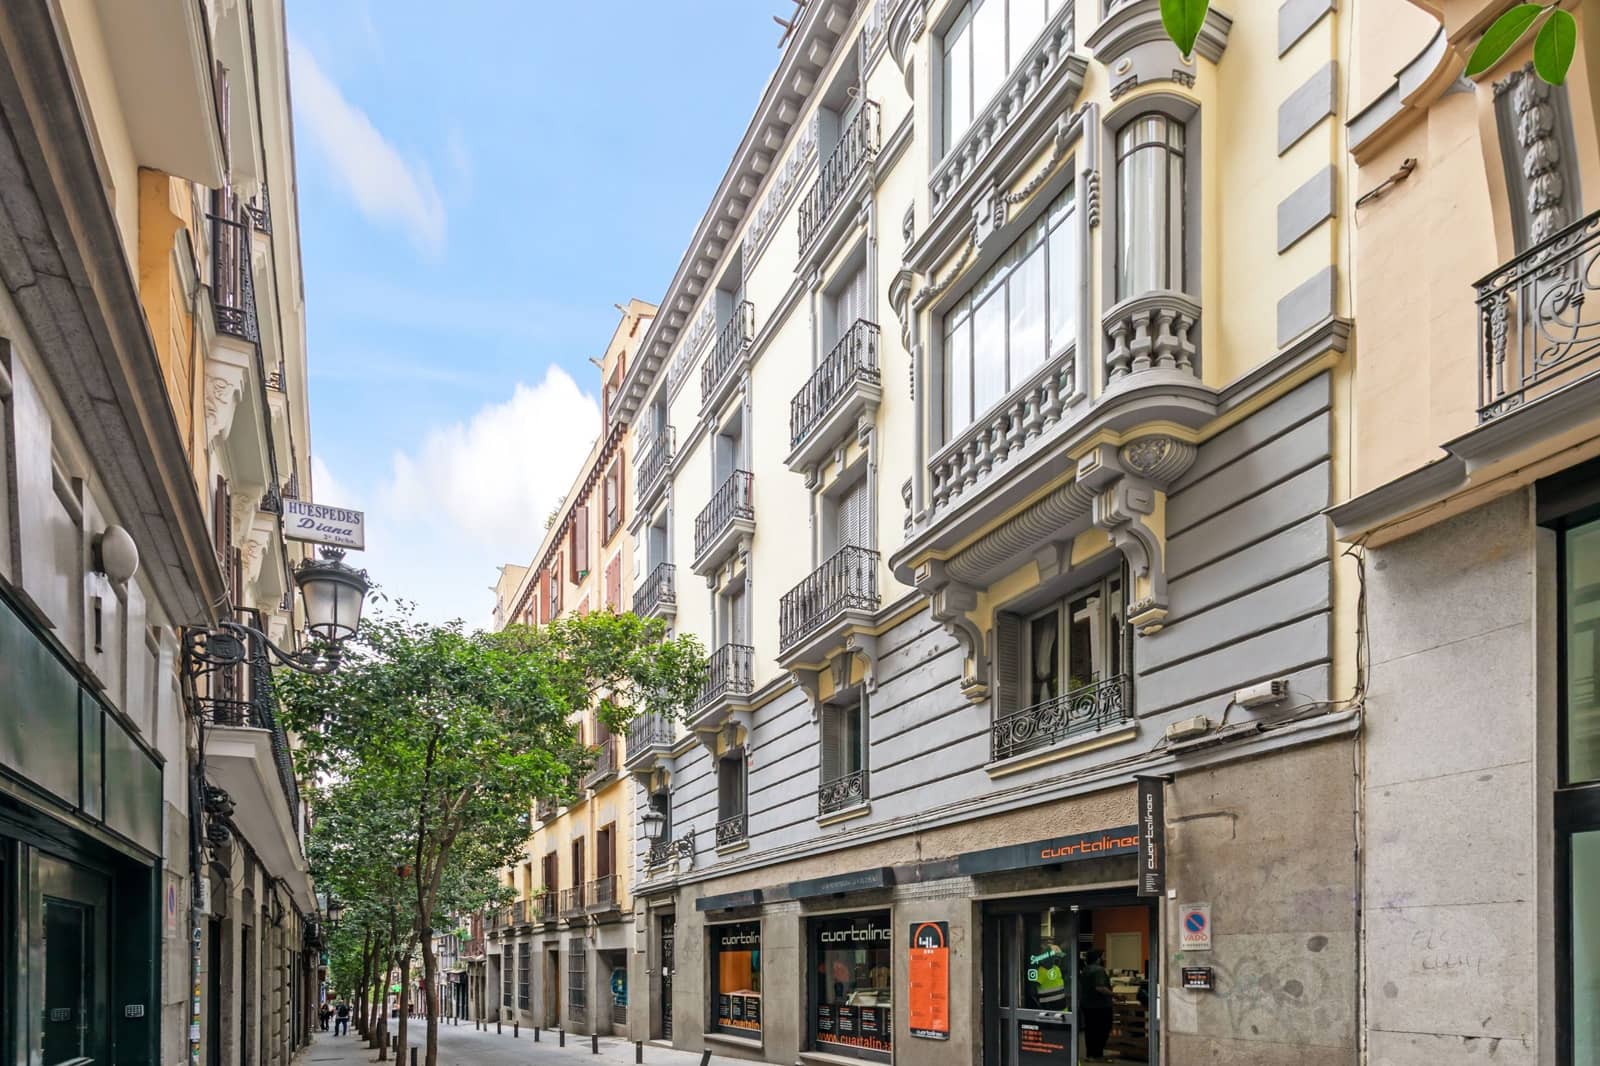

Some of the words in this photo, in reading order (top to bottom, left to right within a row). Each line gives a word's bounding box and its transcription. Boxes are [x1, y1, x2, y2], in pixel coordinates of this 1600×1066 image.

[288, 501, 361, 525] HUESPEDES
[297, 517, 353, 536] Diana
[1183, 934, 1208, 942] VADO
